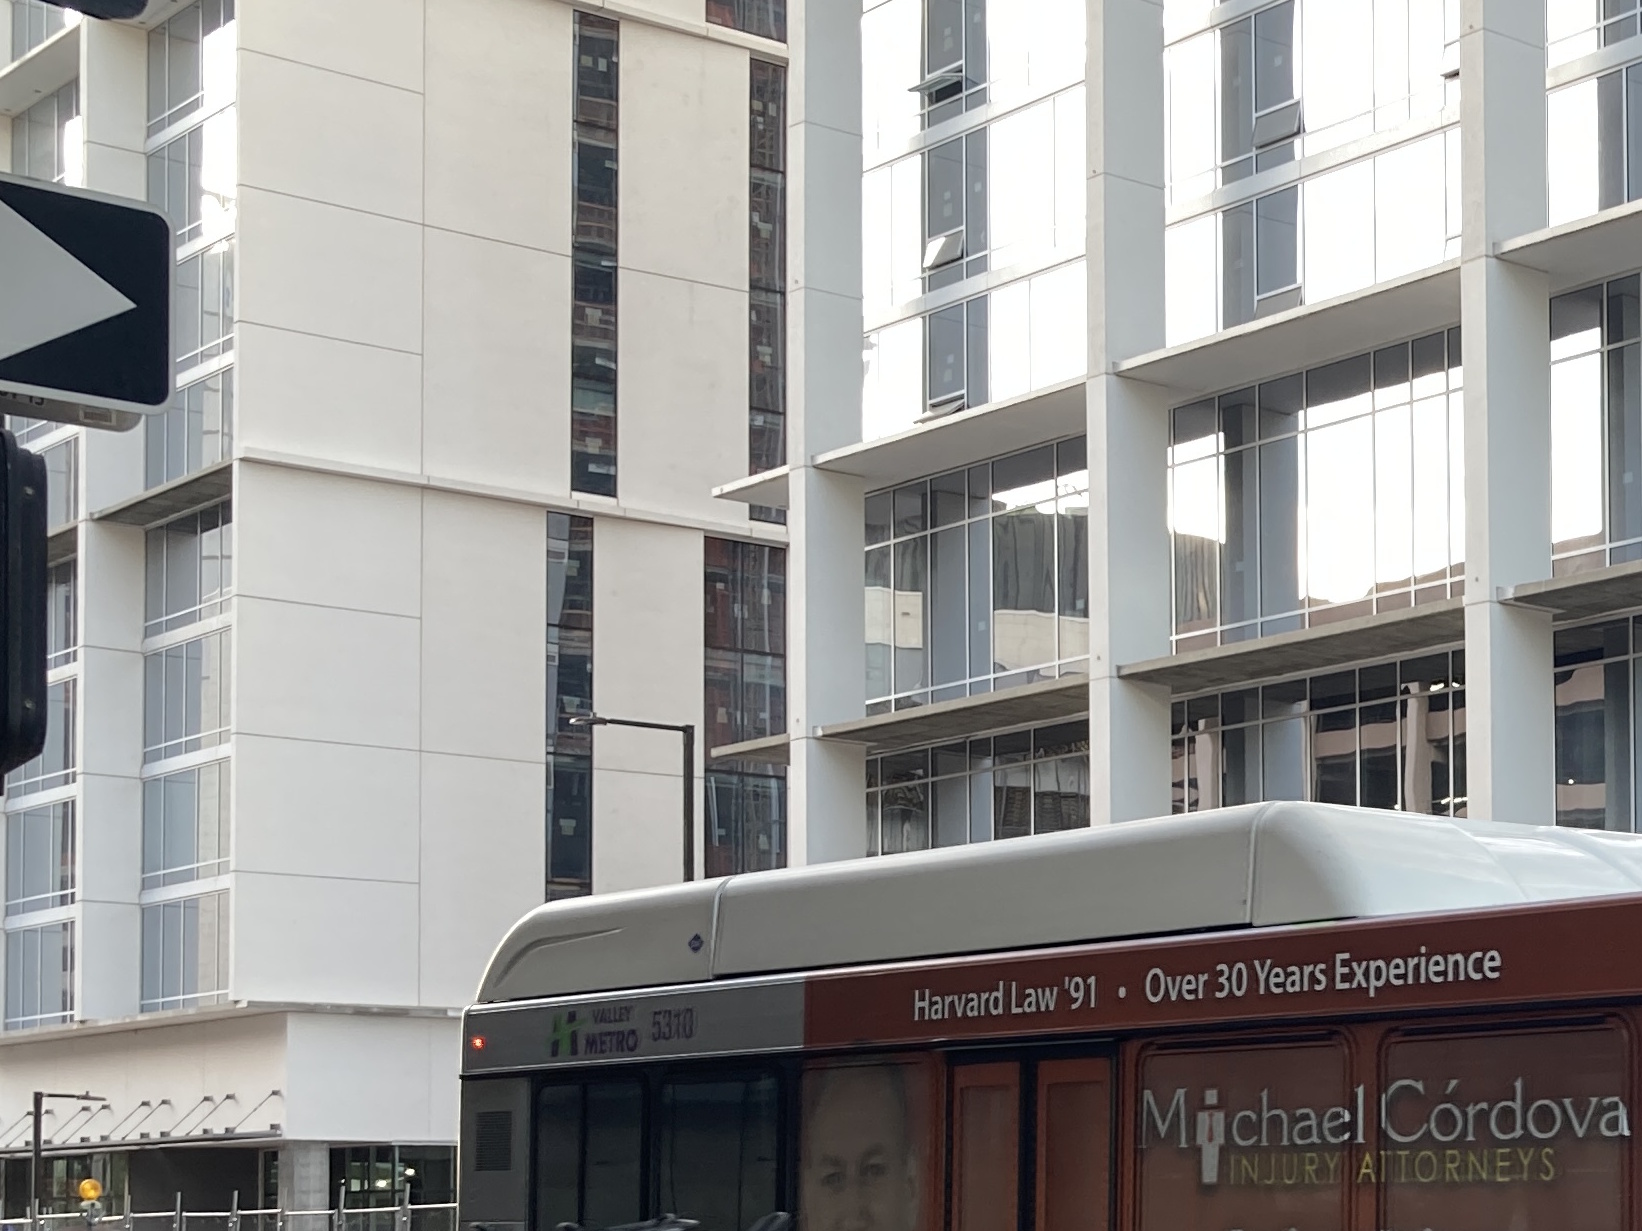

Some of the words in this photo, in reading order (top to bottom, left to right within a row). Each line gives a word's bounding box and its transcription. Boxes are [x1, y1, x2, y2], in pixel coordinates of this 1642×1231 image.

[913, 980, 1004, 1021] Harvard
[1010, 981, 1058, 1015] Law
[1064, 975, 1097, 1010] '91
[1145, 967, 1208, 1003] Over
[1215, 962, 1248, 998] 30
[1253, 958, 1327, 995] Years
[1334, 945, 1502, 997] Experience
[592, 1005, 634, 1024] VALLEY
[651, 1007, 695, 1042] 5310
[584, 1028, 639, 1055] METRO
[1137, 1083, 1366, 1184] Michael
[1381, 1076, 1632, 1144] Córdova
[1229, 1152, 1342, 1185] INJURY
[1356, 1146, 1556, 1184] ATTORNEYS
